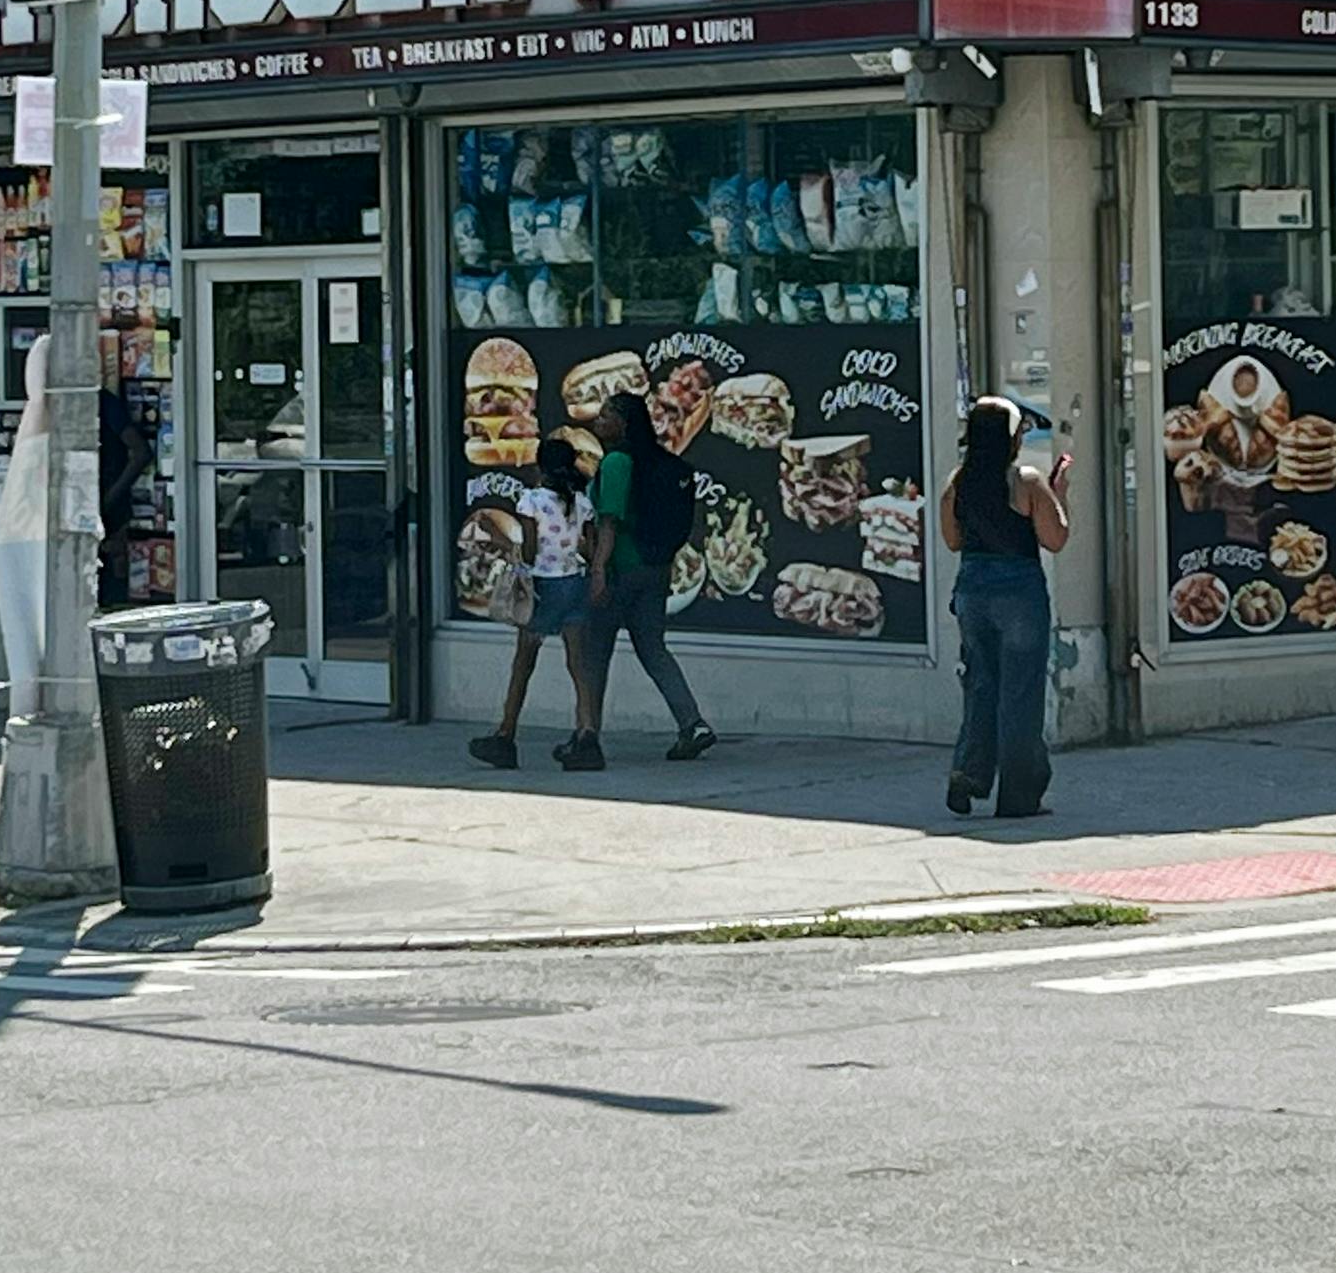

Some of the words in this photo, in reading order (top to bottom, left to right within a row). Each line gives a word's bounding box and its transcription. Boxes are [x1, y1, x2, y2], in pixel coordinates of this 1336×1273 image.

[1144, 1, 1199, 28] 1133
[351, 46, 383, 70] TEA
[402, 36, 495, 67] BREAKFAST
[516, 32, 550, 58] EBT
[571, 28, 607, 54] WIC
[630, 23, 670, 51] ATM
[692, 16, 755, 45] LUNCH
[138, 57, 238, 86] SANDWICHES
[254, 52, 310, 78] COFFEE
[644, 331, 746, 374] SANDWICHES
[841, 348, 898, 378] COLD
[1163, 321, 1240, 371] MORNING
[1240, 321, 1336, 375] BREAKFAST
[466, 471, 525, 506] BURGER
